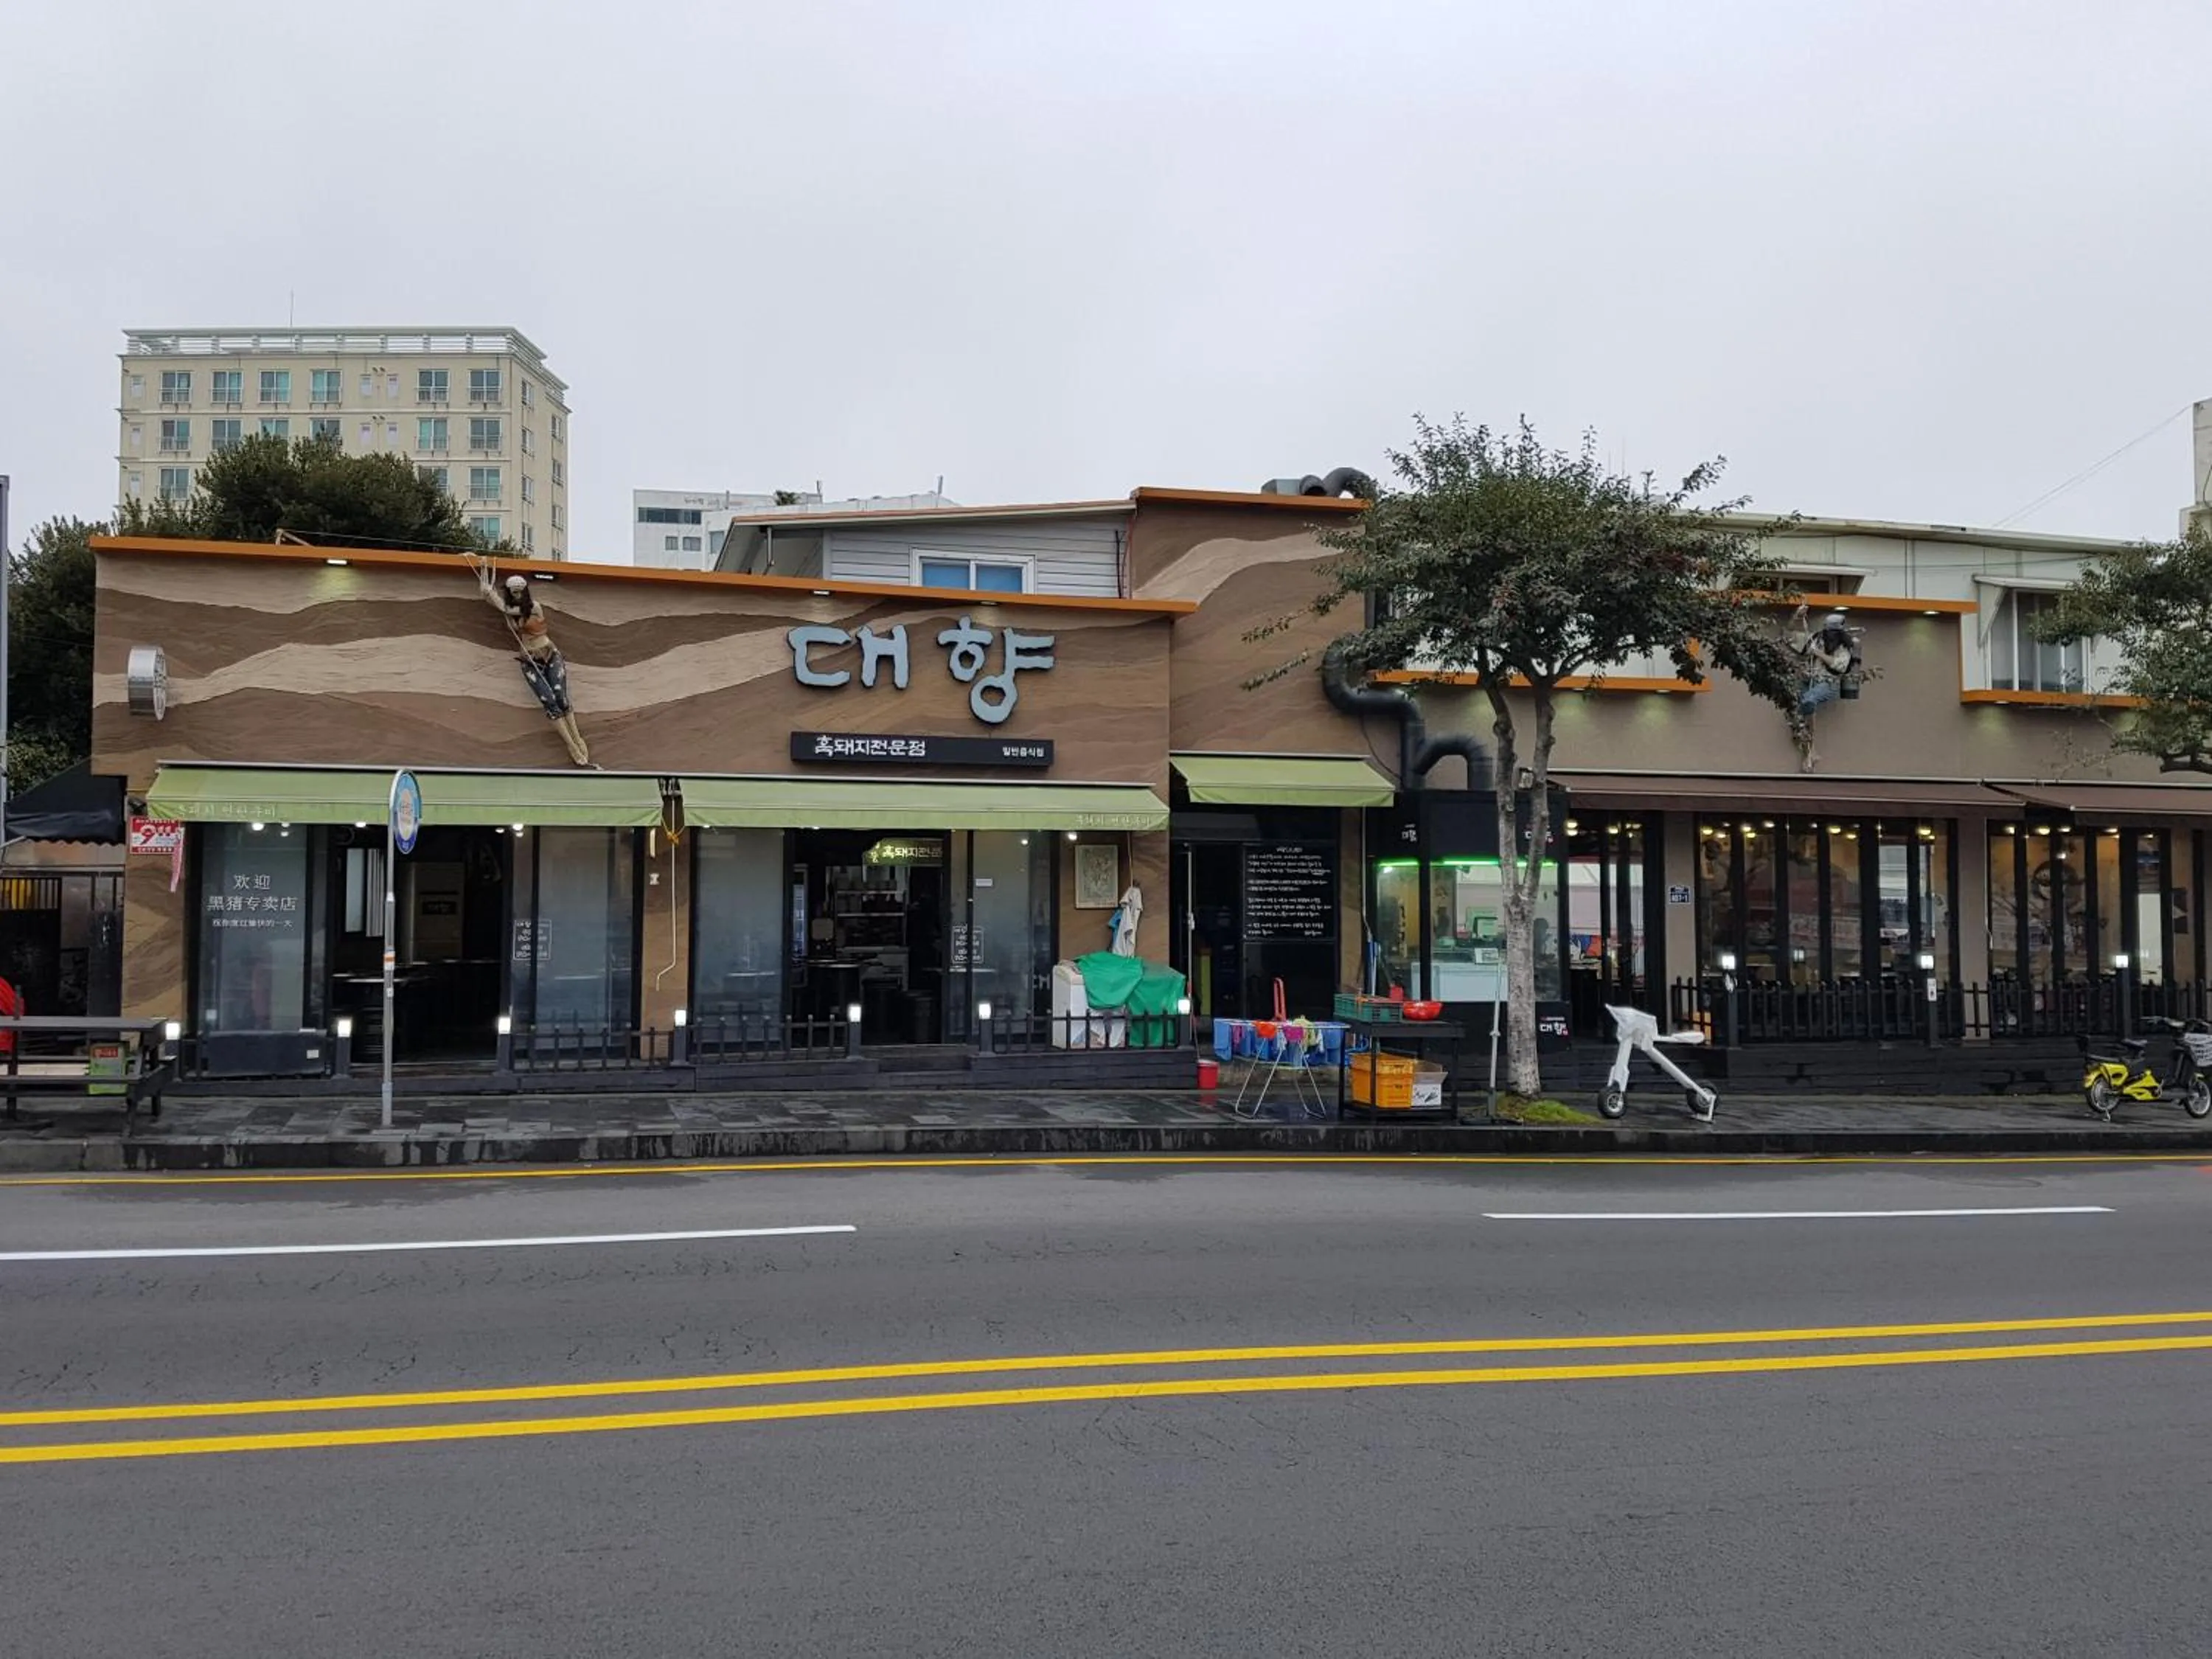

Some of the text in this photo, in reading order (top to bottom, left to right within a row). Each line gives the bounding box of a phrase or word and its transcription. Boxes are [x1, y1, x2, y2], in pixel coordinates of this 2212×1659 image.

[814, 735, 1045, 758] 흑돼지전문점 일반음식점
[206, 895, 298, 911] 黑猪专卖店
